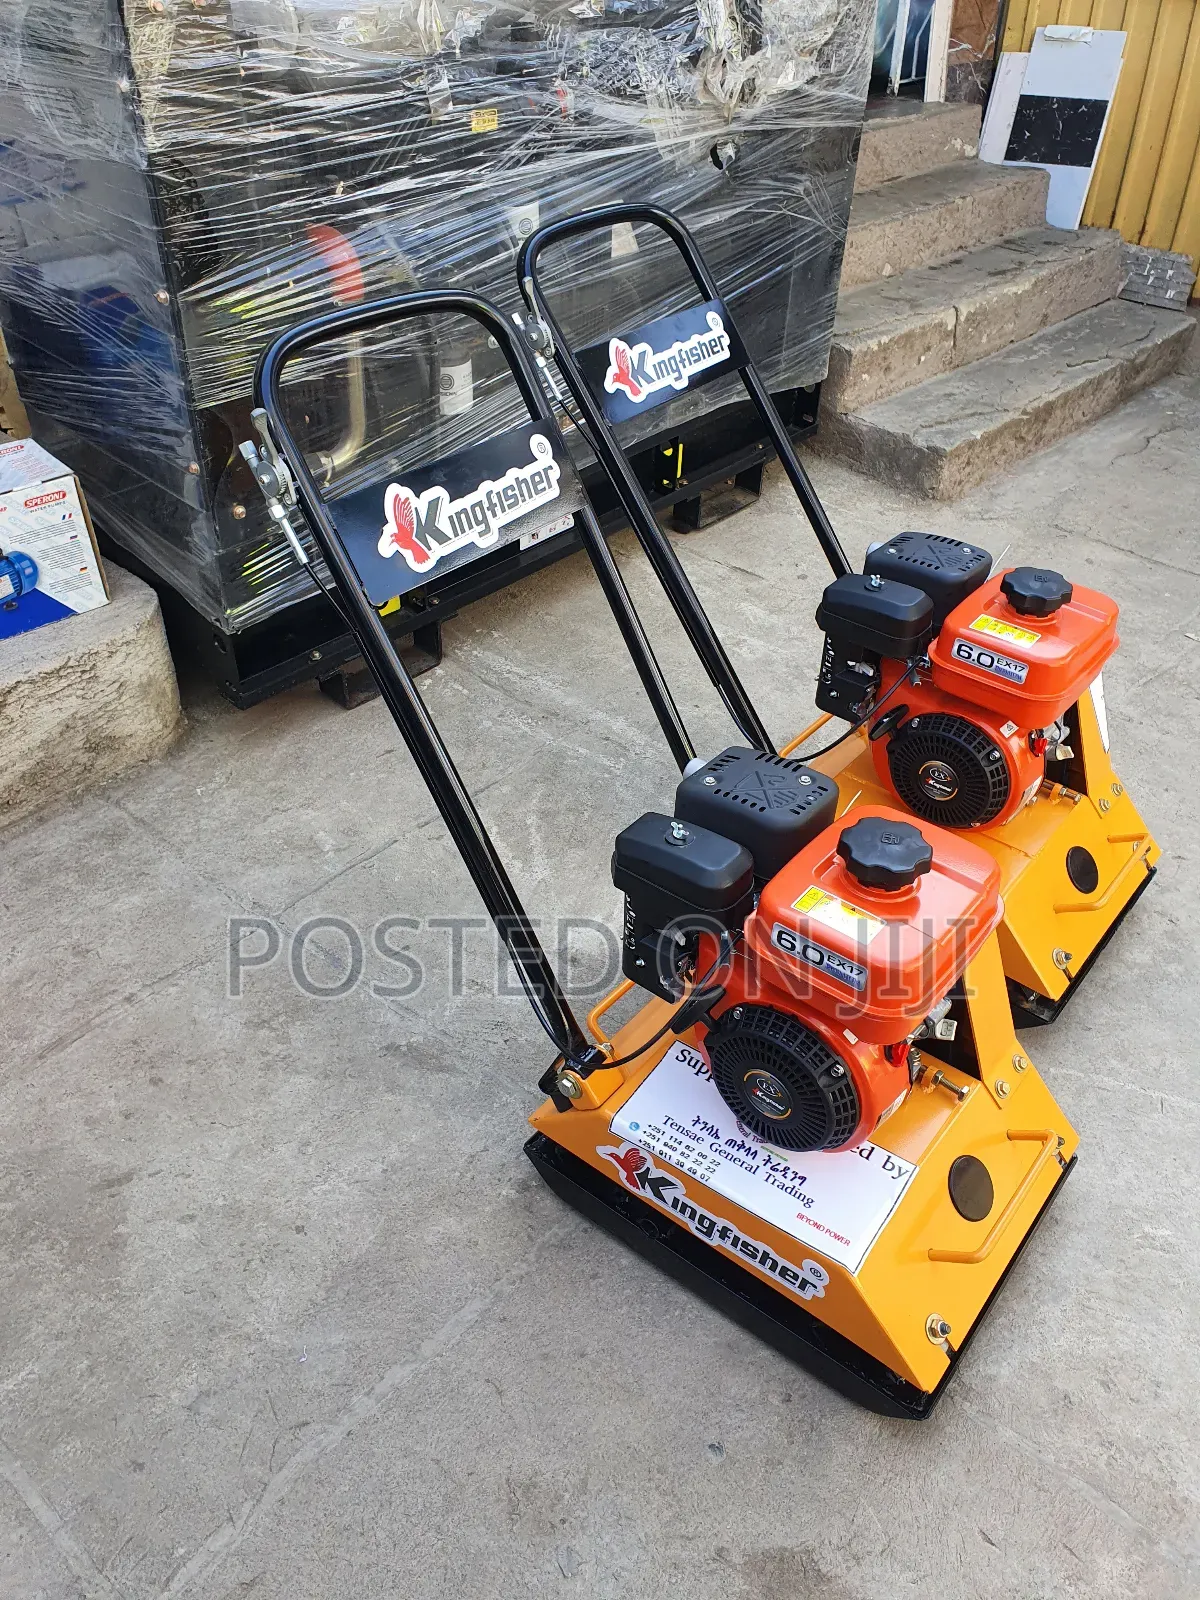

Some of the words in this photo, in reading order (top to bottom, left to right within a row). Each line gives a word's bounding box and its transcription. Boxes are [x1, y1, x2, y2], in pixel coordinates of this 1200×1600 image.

[630, 334, 725, 388] Kingfisher
[26, 490, 65, 508] SPERONI
[414, 465, 554, 551] Kingfisher
[956, 643, 995, 669] 6.0
[996, 657, 1026, 673] EX17
[776, 929, 825, 966] 6.0
[827, 954, 864, 976] EX17
[638, 1138, 656, 1152] +251
[699, 1173, 711, 1183] 07
[643, 1130, 661, 1143] +251
[692, 1158, 703, 1167] 22
[704, 1165, 716, 1175] 22
[648, 1123, 666, 1136] +251
[669, 1135, 683, 1146] 114
[697, 1151, 708, 1160] 00
[709, 1158, 721, 1168] 22
[662, 1114, 705, 1145] Tensae
[709, 1141, 761, 1176] General
[763, 1171, 816, 1209] Trading
[881, 1154, 910, 1180] by
[635, 1166, 820, 1294] Kingfisher
[796, 1212, 826, 1232] BEYOND
[824, 1227, 852, 1247] POWER
